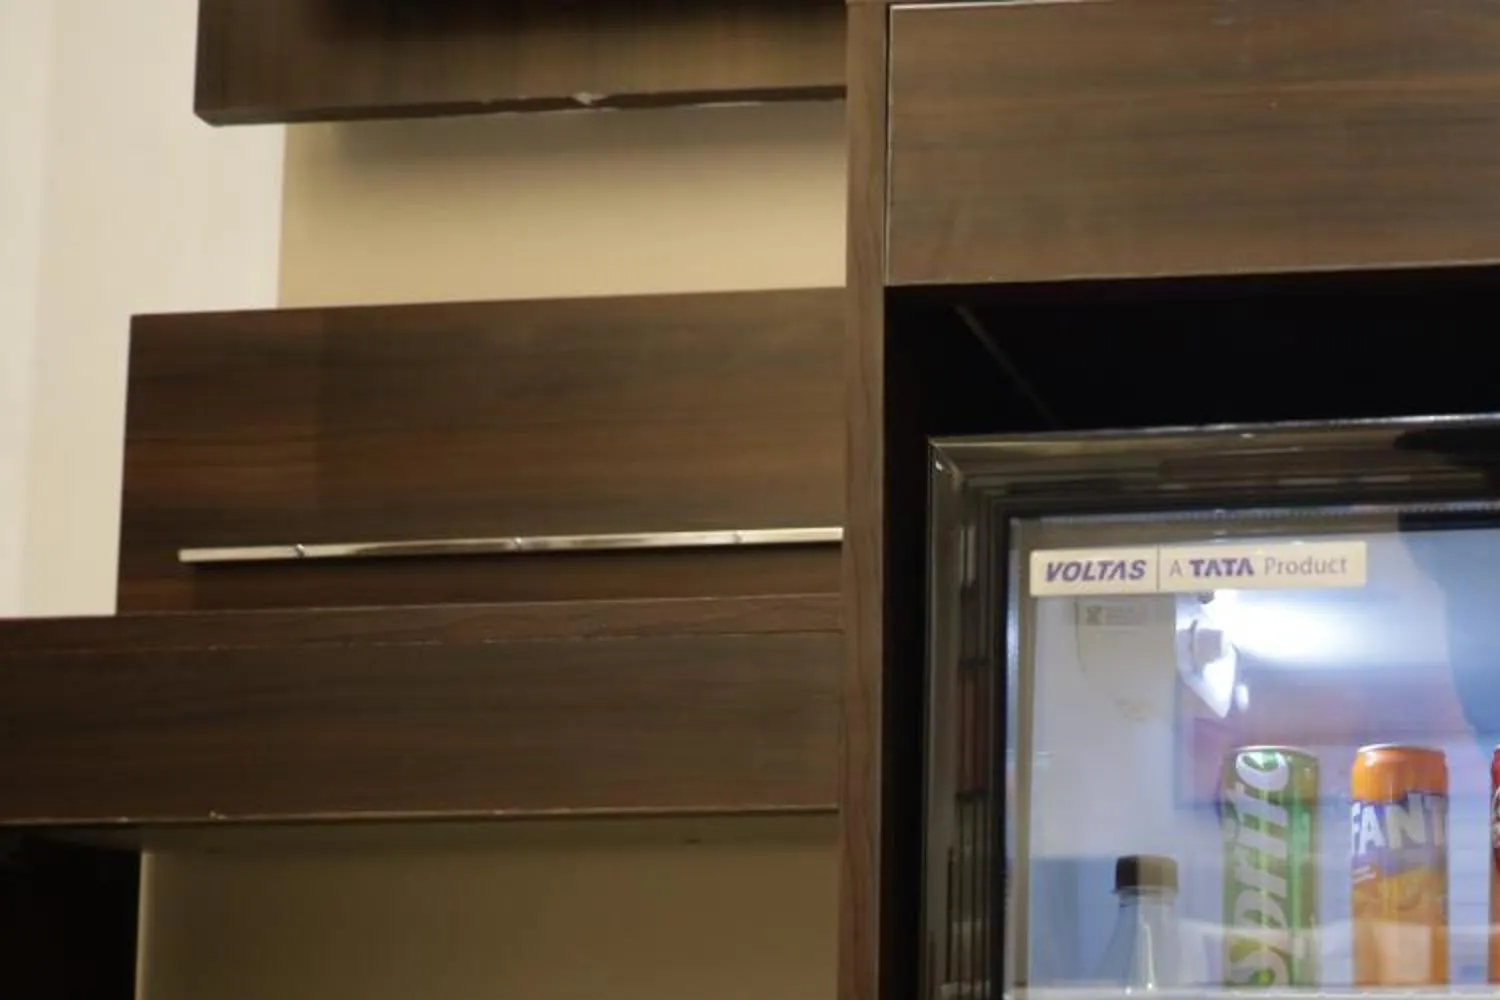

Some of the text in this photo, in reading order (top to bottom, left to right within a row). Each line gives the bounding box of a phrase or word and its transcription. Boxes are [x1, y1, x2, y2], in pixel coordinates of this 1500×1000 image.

[1045, 554, 1348, 584] VOLTAS A TATA Product
[1350, 792, 1446, 858] FANT
